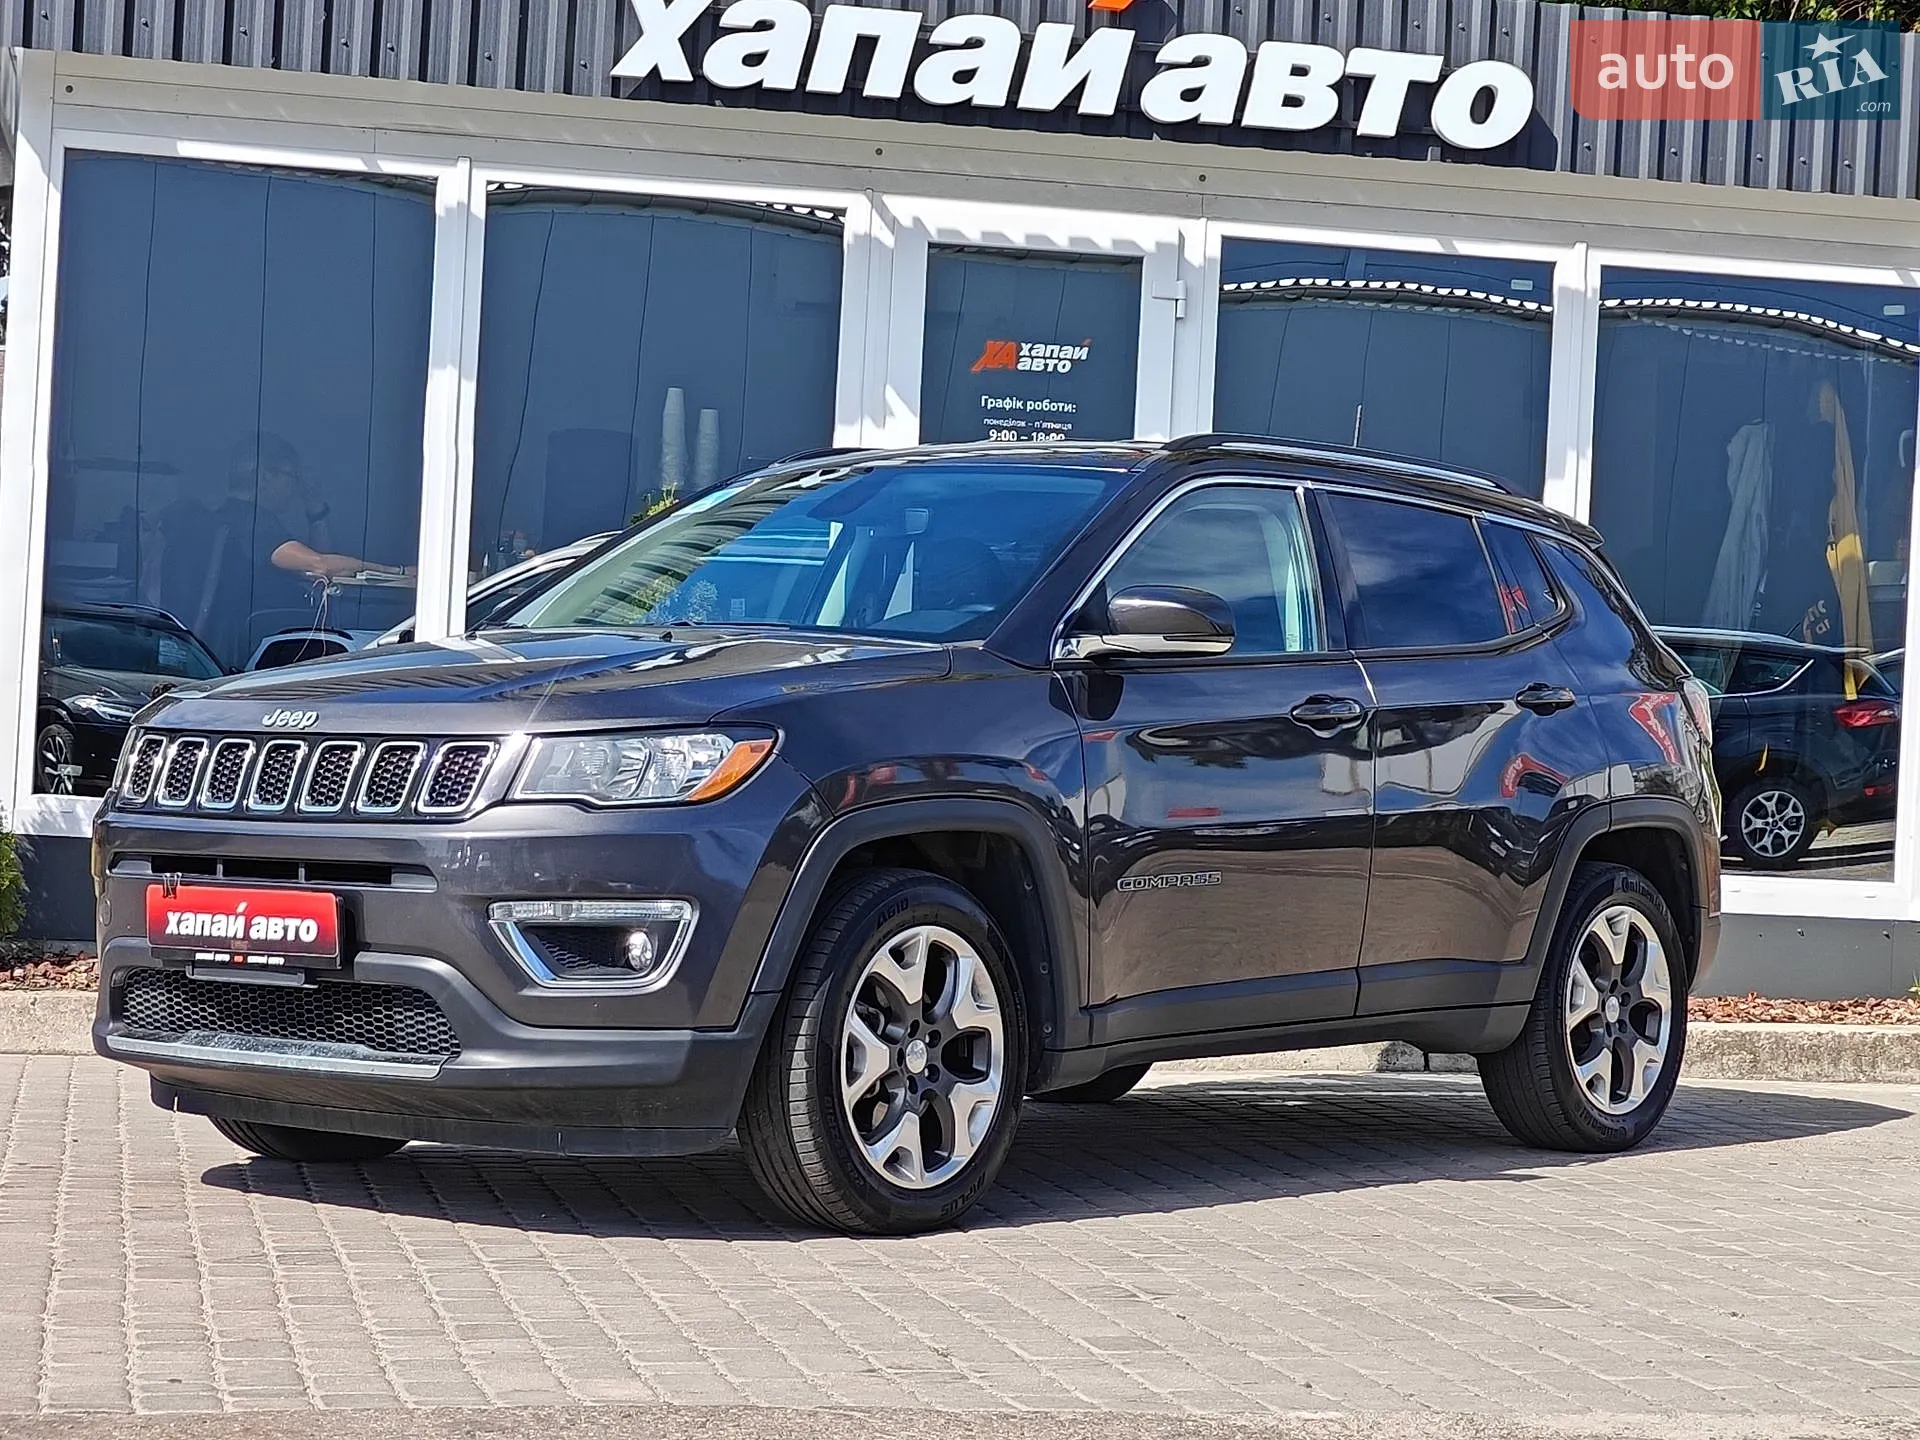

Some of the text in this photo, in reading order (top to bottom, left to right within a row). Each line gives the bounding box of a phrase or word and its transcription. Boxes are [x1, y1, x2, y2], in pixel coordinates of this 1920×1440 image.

[1140, 33, 1535, 150] авто
[1018, 337, 1093, 361] хапай
[1016, 356, 1073, 374] авто
[981, 395, 1077, 413] Графік роботи:
[989, 429, 1018, 442] 9:00
[262, 708, 319, 730] Jeep
[1117, 871, 1222, 892] COMPASS
[165, 901, 319, 943] хапай авто
